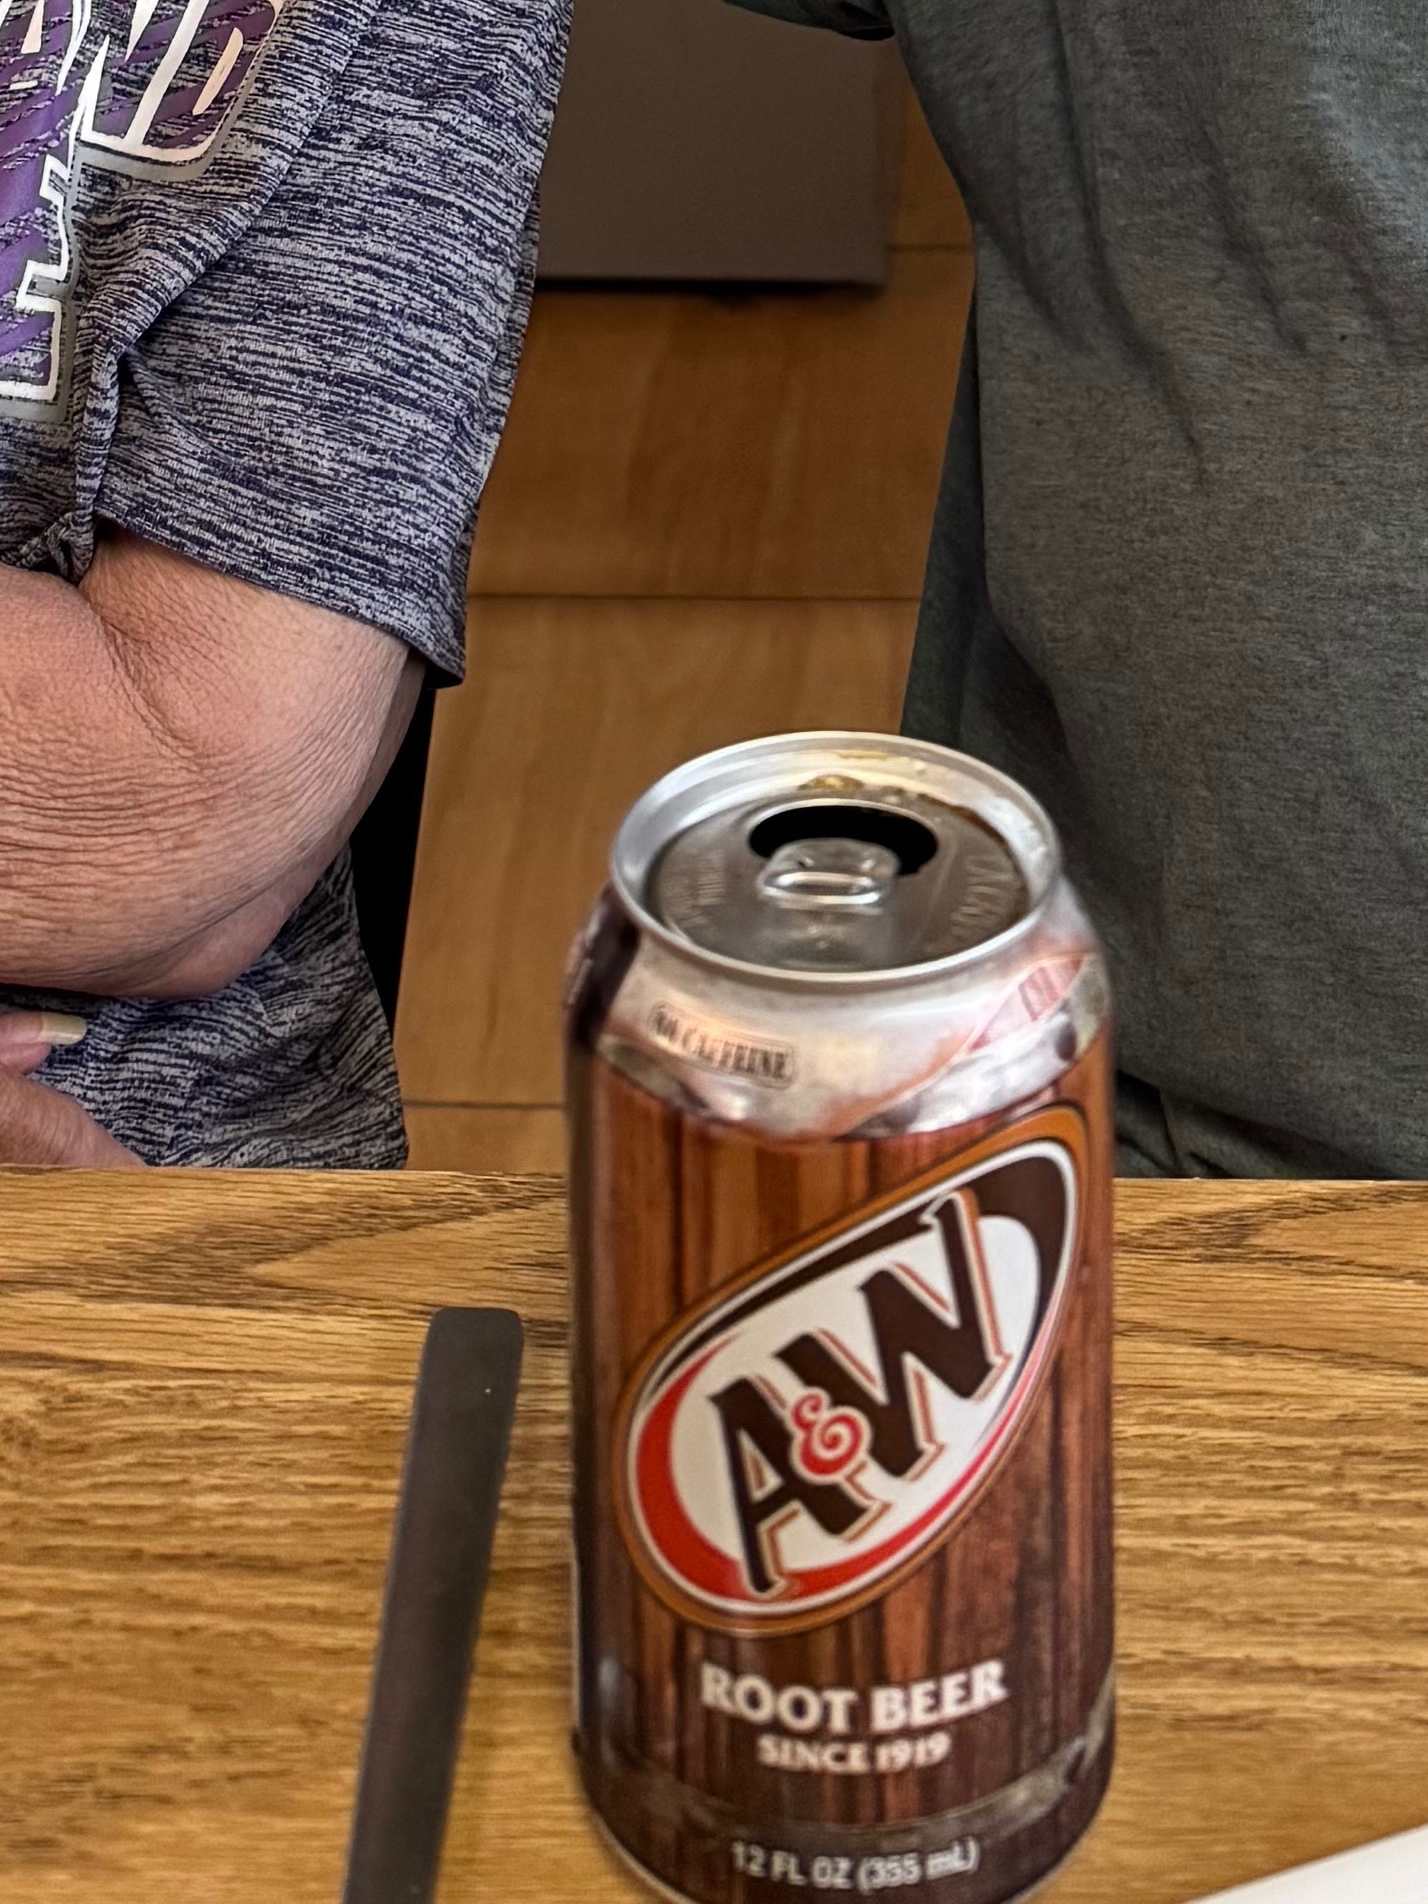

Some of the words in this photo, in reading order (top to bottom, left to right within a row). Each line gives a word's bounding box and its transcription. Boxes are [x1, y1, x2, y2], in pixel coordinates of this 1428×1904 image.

[710, 1190, 1012, 1597] A&W
[700, 1662, 860, 1736] ROOT
[872, 1658, 1010, 1733] BEER
[757, 1733, 869, 1775] SINCE
[875, 1731, 953, 1774] 1919
[732, 1840, 768, 1878] 12
[771, 1848, 809, 1887] FL
[812, 1856, 853, 1889] OZ
[857, 1851, 921, 1895] (355
[926, 1836, 981, 1879] mL)
